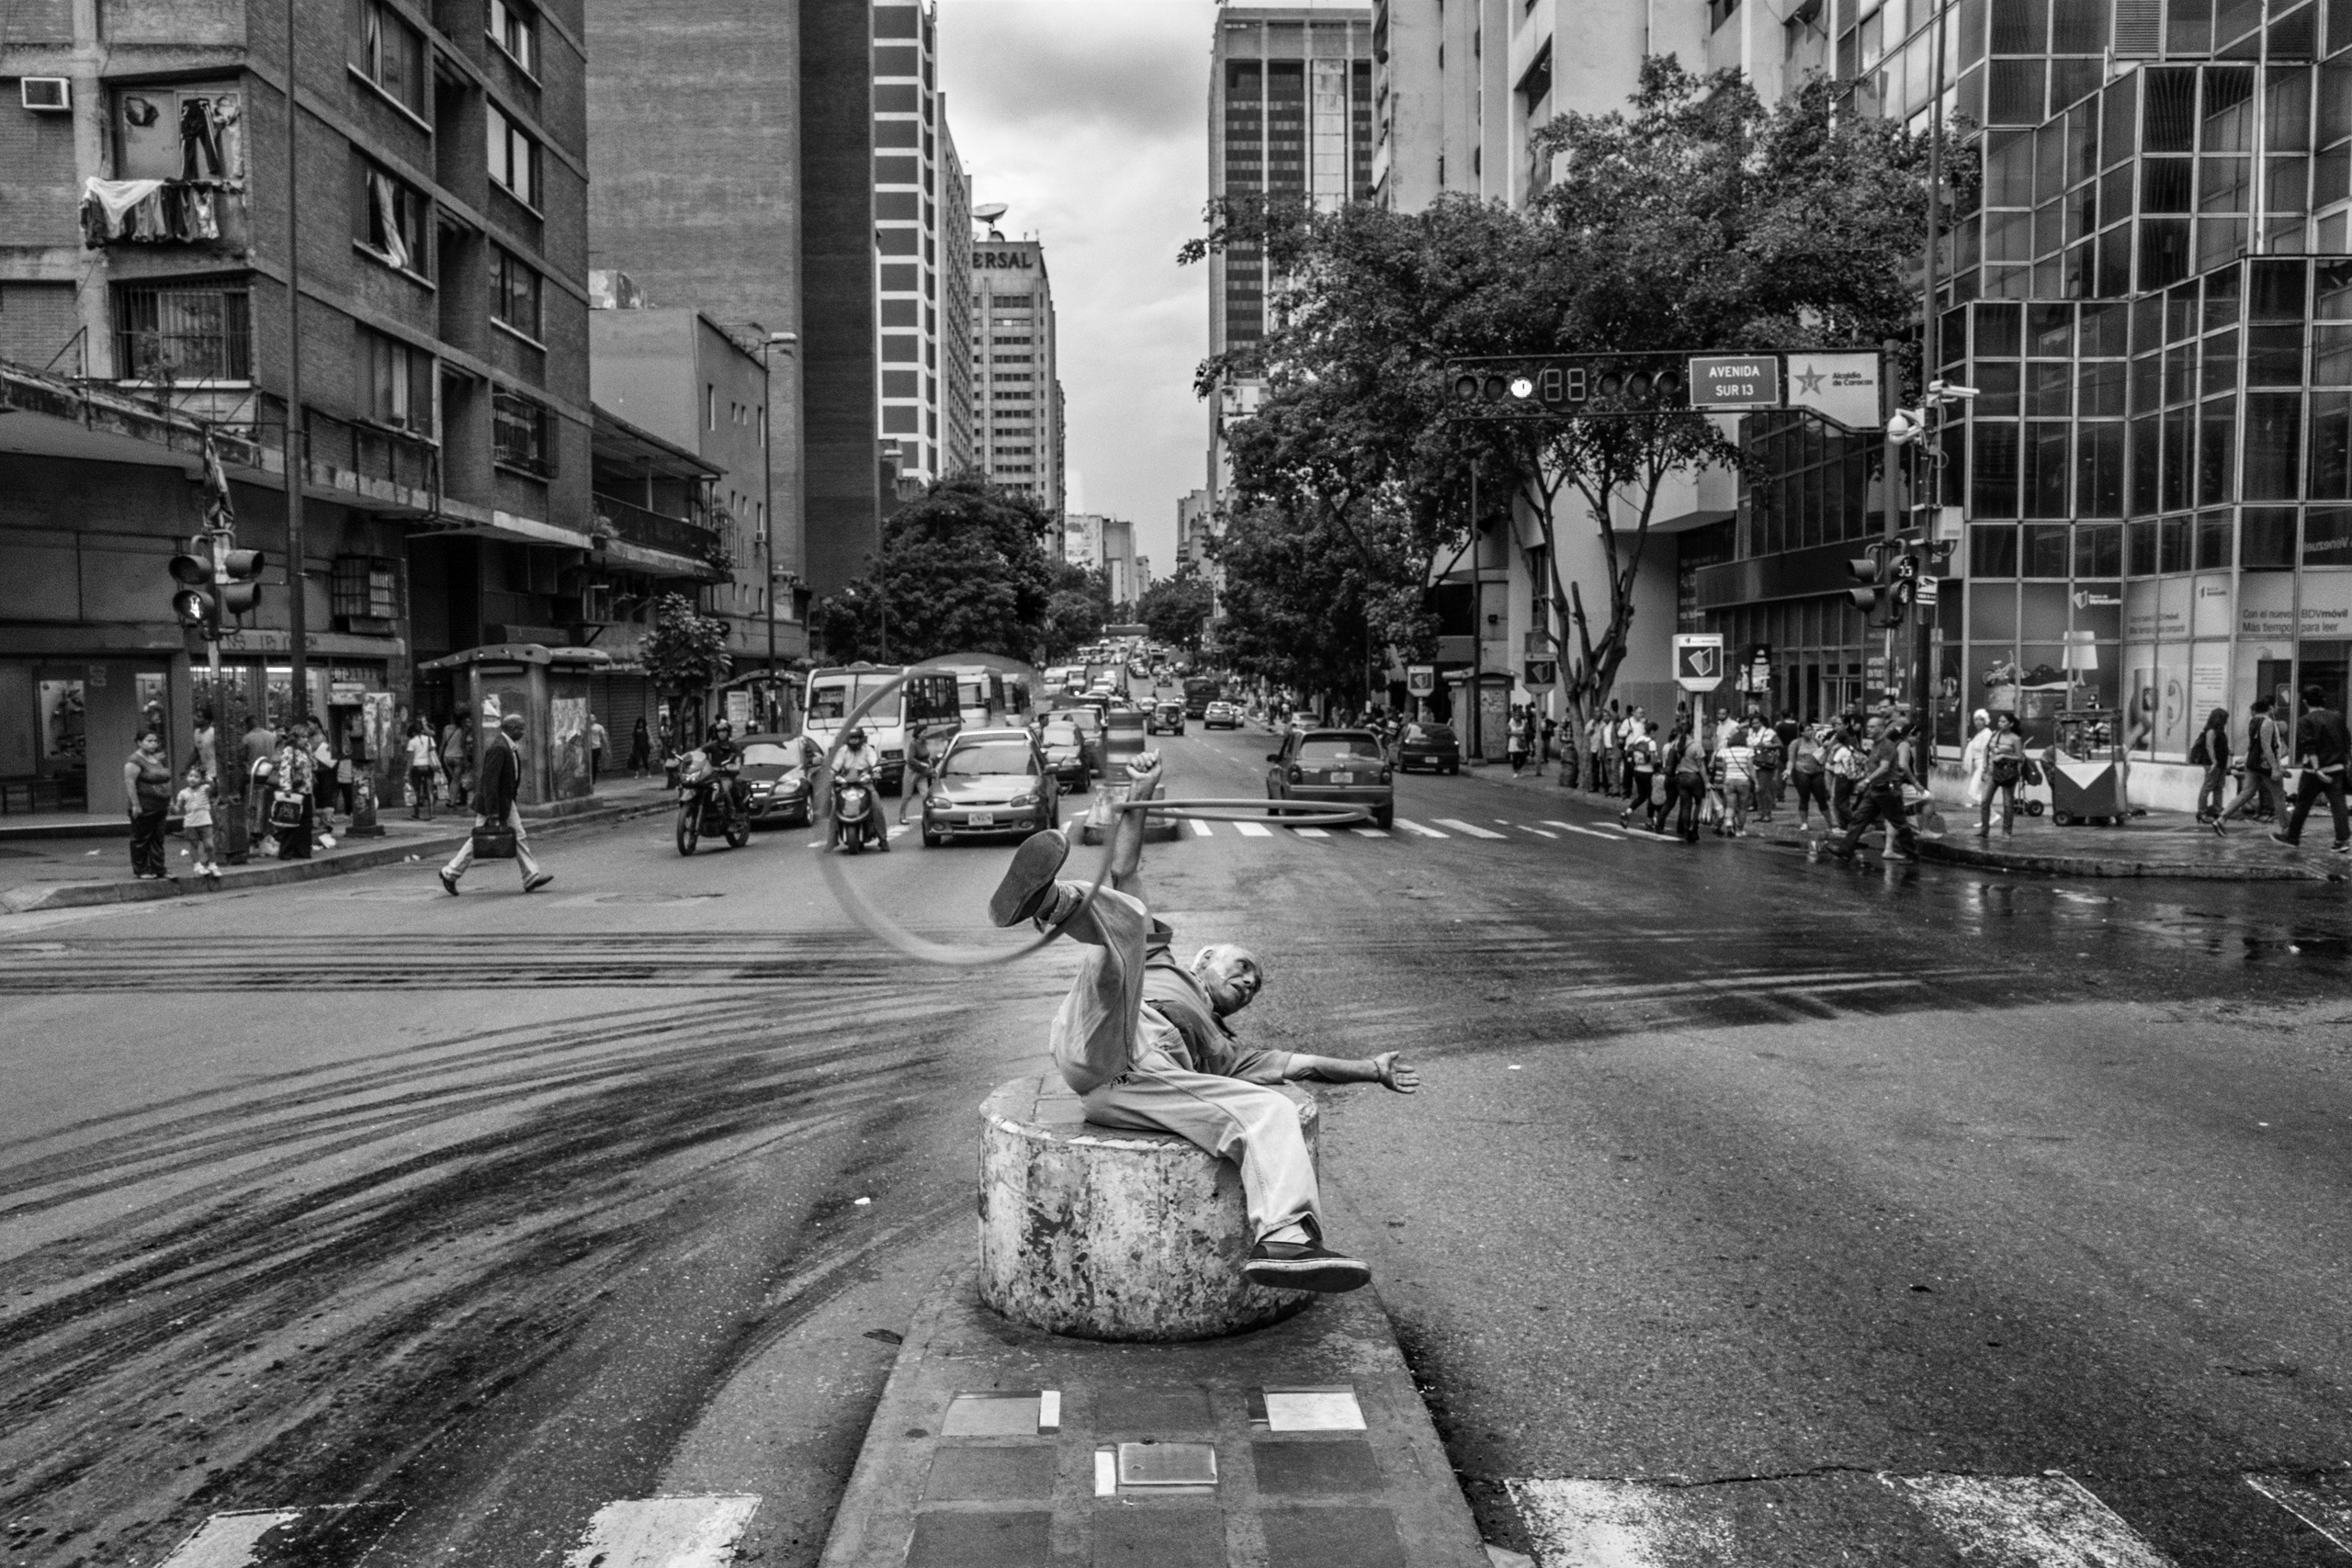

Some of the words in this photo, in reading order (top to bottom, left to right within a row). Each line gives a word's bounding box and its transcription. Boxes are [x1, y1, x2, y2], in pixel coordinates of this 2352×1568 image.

[1709, 366, 1760, 378] AVENIDA
[1715, 384, 1739, 397] SUR
[1742, 384, 1754, 396] 13
[2243, 609, 2258, 619] Con
[2260, 610, 2267, 618] el
[2269, 611, 2293, 619] nuevo
[2243, 622, 2260, 632] Más
[2263, 622, 2293, 635] tiempo
[2301, 625, 2320, 634] para
[2322, 622, 2338, 632] leer
